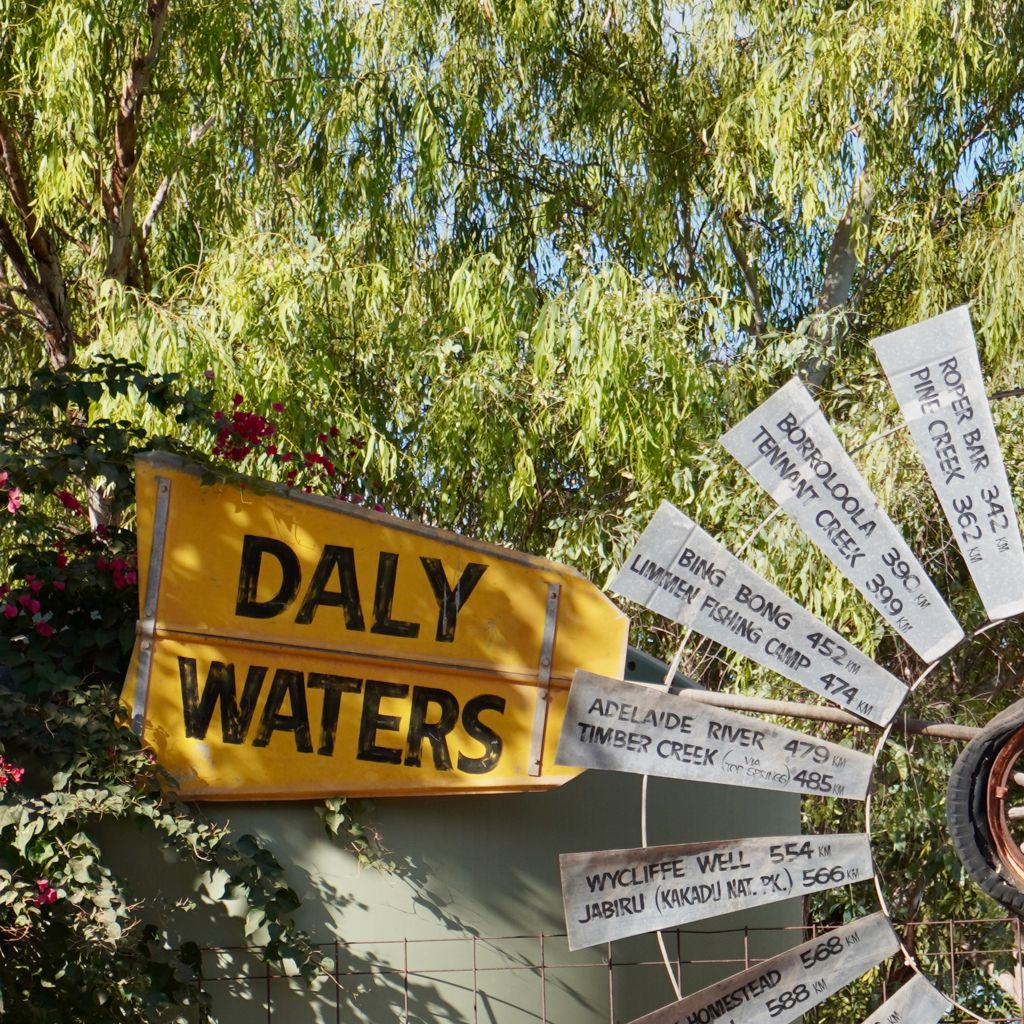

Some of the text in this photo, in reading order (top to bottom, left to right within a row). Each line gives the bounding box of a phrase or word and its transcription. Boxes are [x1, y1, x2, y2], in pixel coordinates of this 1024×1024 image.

[774, 411, 931, 611] BORROLOOLA 390 KM
[908, 365, 985, 564] PINE CREEK 362 KM
[936, 355, 1011, 553] ROPER BAR 342 KM
[747, 423, 913, 634] TENNANT CREEK 399 KM
[235, 534, 488, 642] DALY
[628, 553, 874, 716] LIMMEN FISHING CAMP 474 KM
[676, 547, 861, 675] BING BONG 452 KM
[178, 655, 506, 775] WATERS
[574, 721, 845, 796] TIMBER CREEK 485 KM
[587, 696, 847, 769] ADELAIDE RIVER 479 KM
[575, 863, 859, 924] JABIRU (KAKADU NAT. PK.) 566 KM
[584, 840, 832, 893] WYCLIFFE WELL 554 KM
[763, 981, 813, 1019] 588
[811, 978, 829, 995] KM
[796, 934, 845, 971] 568
[843, 930, 861, 947] KM
